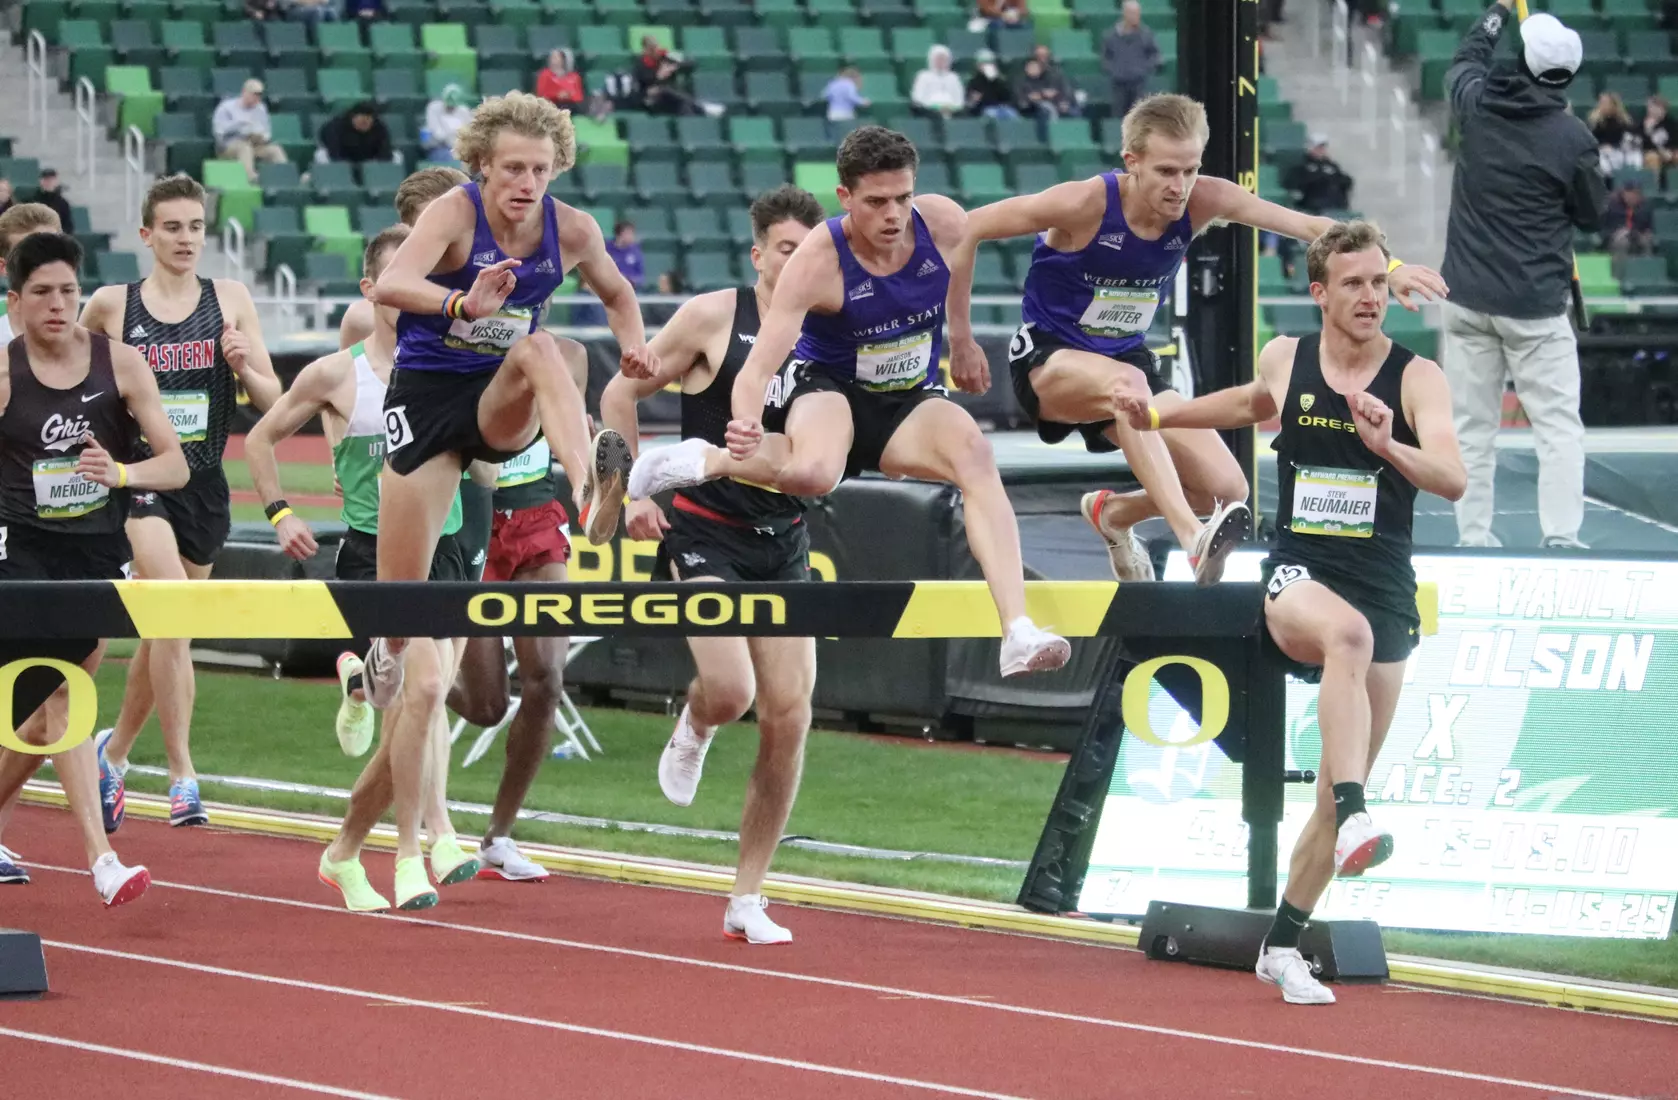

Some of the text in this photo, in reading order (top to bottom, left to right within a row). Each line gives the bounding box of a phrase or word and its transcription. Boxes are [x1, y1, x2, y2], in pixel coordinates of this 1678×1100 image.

[1084, 272, 1128, 287] WEBER
[907, 302, 942, 325] STAT
[1096, 309, 1143, 325] WINTER
[470, 325, 515, 341] VISSER
[874, 355, 921, 377] WILKES
[41, 413, 95, 445] Griz
[168, 413, 198, 427] OSMA
[386, 411, 405, 447] 9
[1298, 415, 1356, 433] OREG
[368, 441, 385, 457] UT
[1310, 470, 1336, 481] HAYWARD
[50, 480, 100, 500] MENDEZ
[1327, 489, 1348, 499] STEVE
[1300, 496, 1372, 516] NEUMAIER
[1497, 566, 1655, 621] VAULT
[467, 591, 787, 627] OREGON
[1448, 629, 1655, 692] OLSON
[0, 656, 98, 755] O
[1121, 655, 1231, 747] O
[1413, 692, 1471, 760] X
[1364, 763, 1523, 806] ACE: 2
